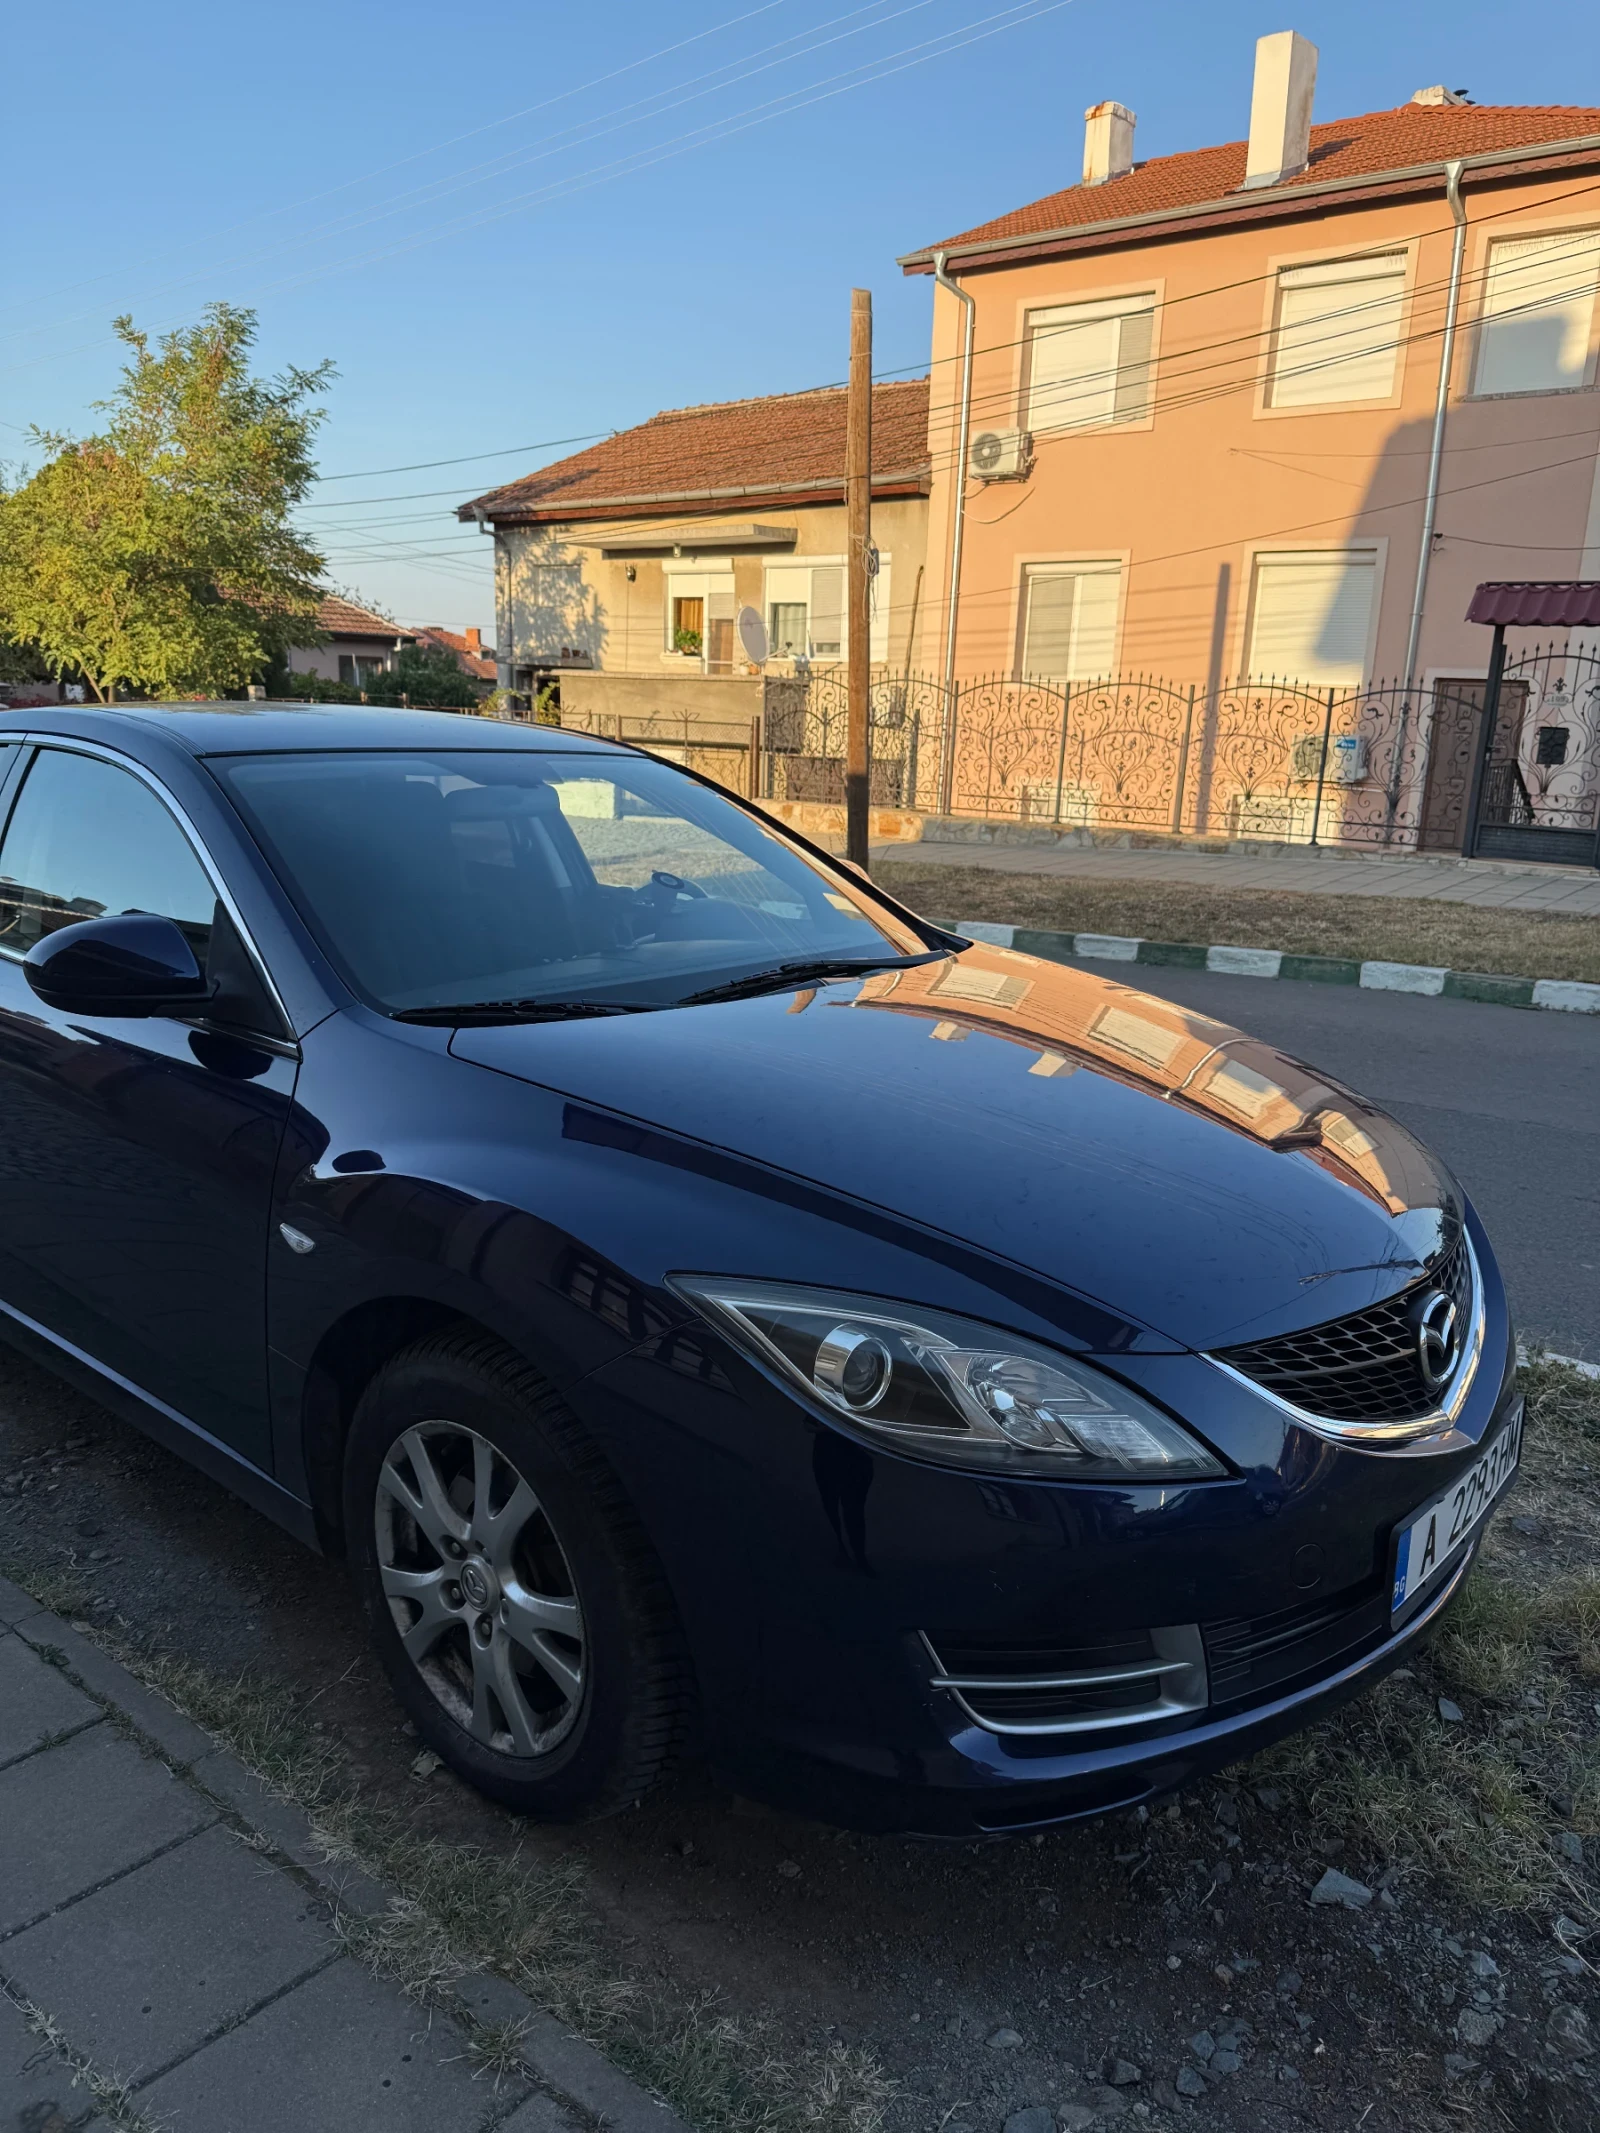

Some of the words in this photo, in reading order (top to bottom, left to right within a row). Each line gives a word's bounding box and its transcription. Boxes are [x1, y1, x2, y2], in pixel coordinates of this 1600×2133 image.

[1419, 1513, 1436, 1577] A
[1447, 1445, 1498, 1548] 2293
[1496, 1411, 1521, 1485] HM
[1393, 1575, 1406, 1598] BG
